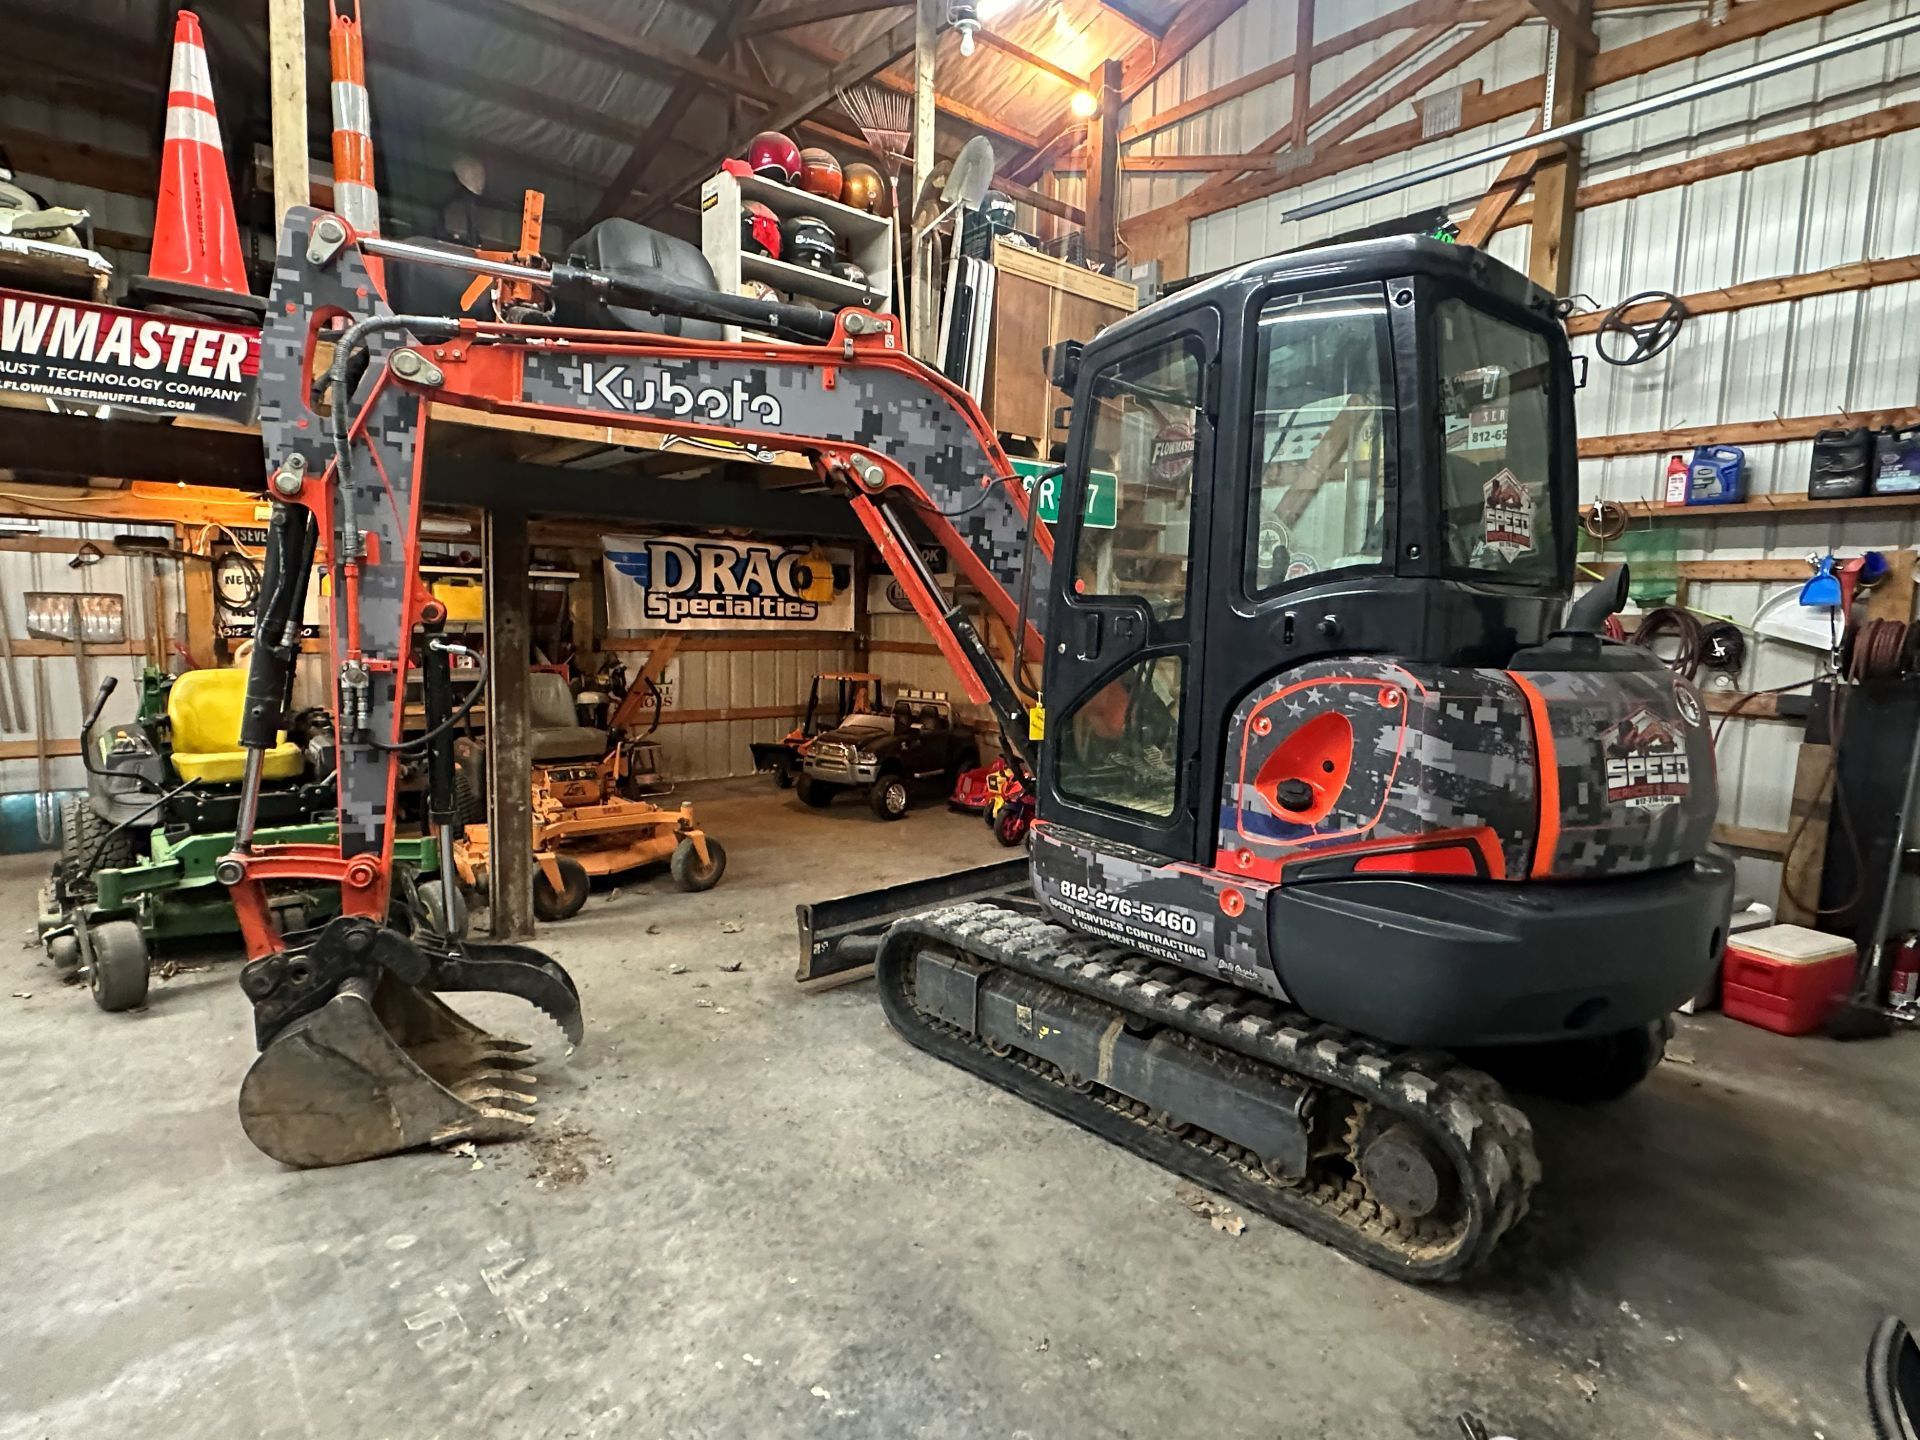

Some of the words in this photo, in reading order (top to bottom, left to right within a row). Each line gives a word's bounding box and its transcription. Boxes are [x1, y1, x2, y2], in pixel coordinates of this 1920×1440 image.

[46, 366, 163, 391] TECHNOLOGY
[165, 382, 242, 402] COMPANY
[582, 362, 783, 426] Kubota
[1486, 508, 1531, 538] SPEED
[647, 594, 816, 621] Specialties
[1606, 755, 1690, 790] SPEED
[1060, 879, 1197, 936] 812-276-5460
[1049, 895, 1075, 916] SPEED
[1075, 907, 1125, 933] SERVICES
[1125, 924, 1207, 960] CONTRACTING
[1078, 920, 1136, 948] EQUIPMENT
